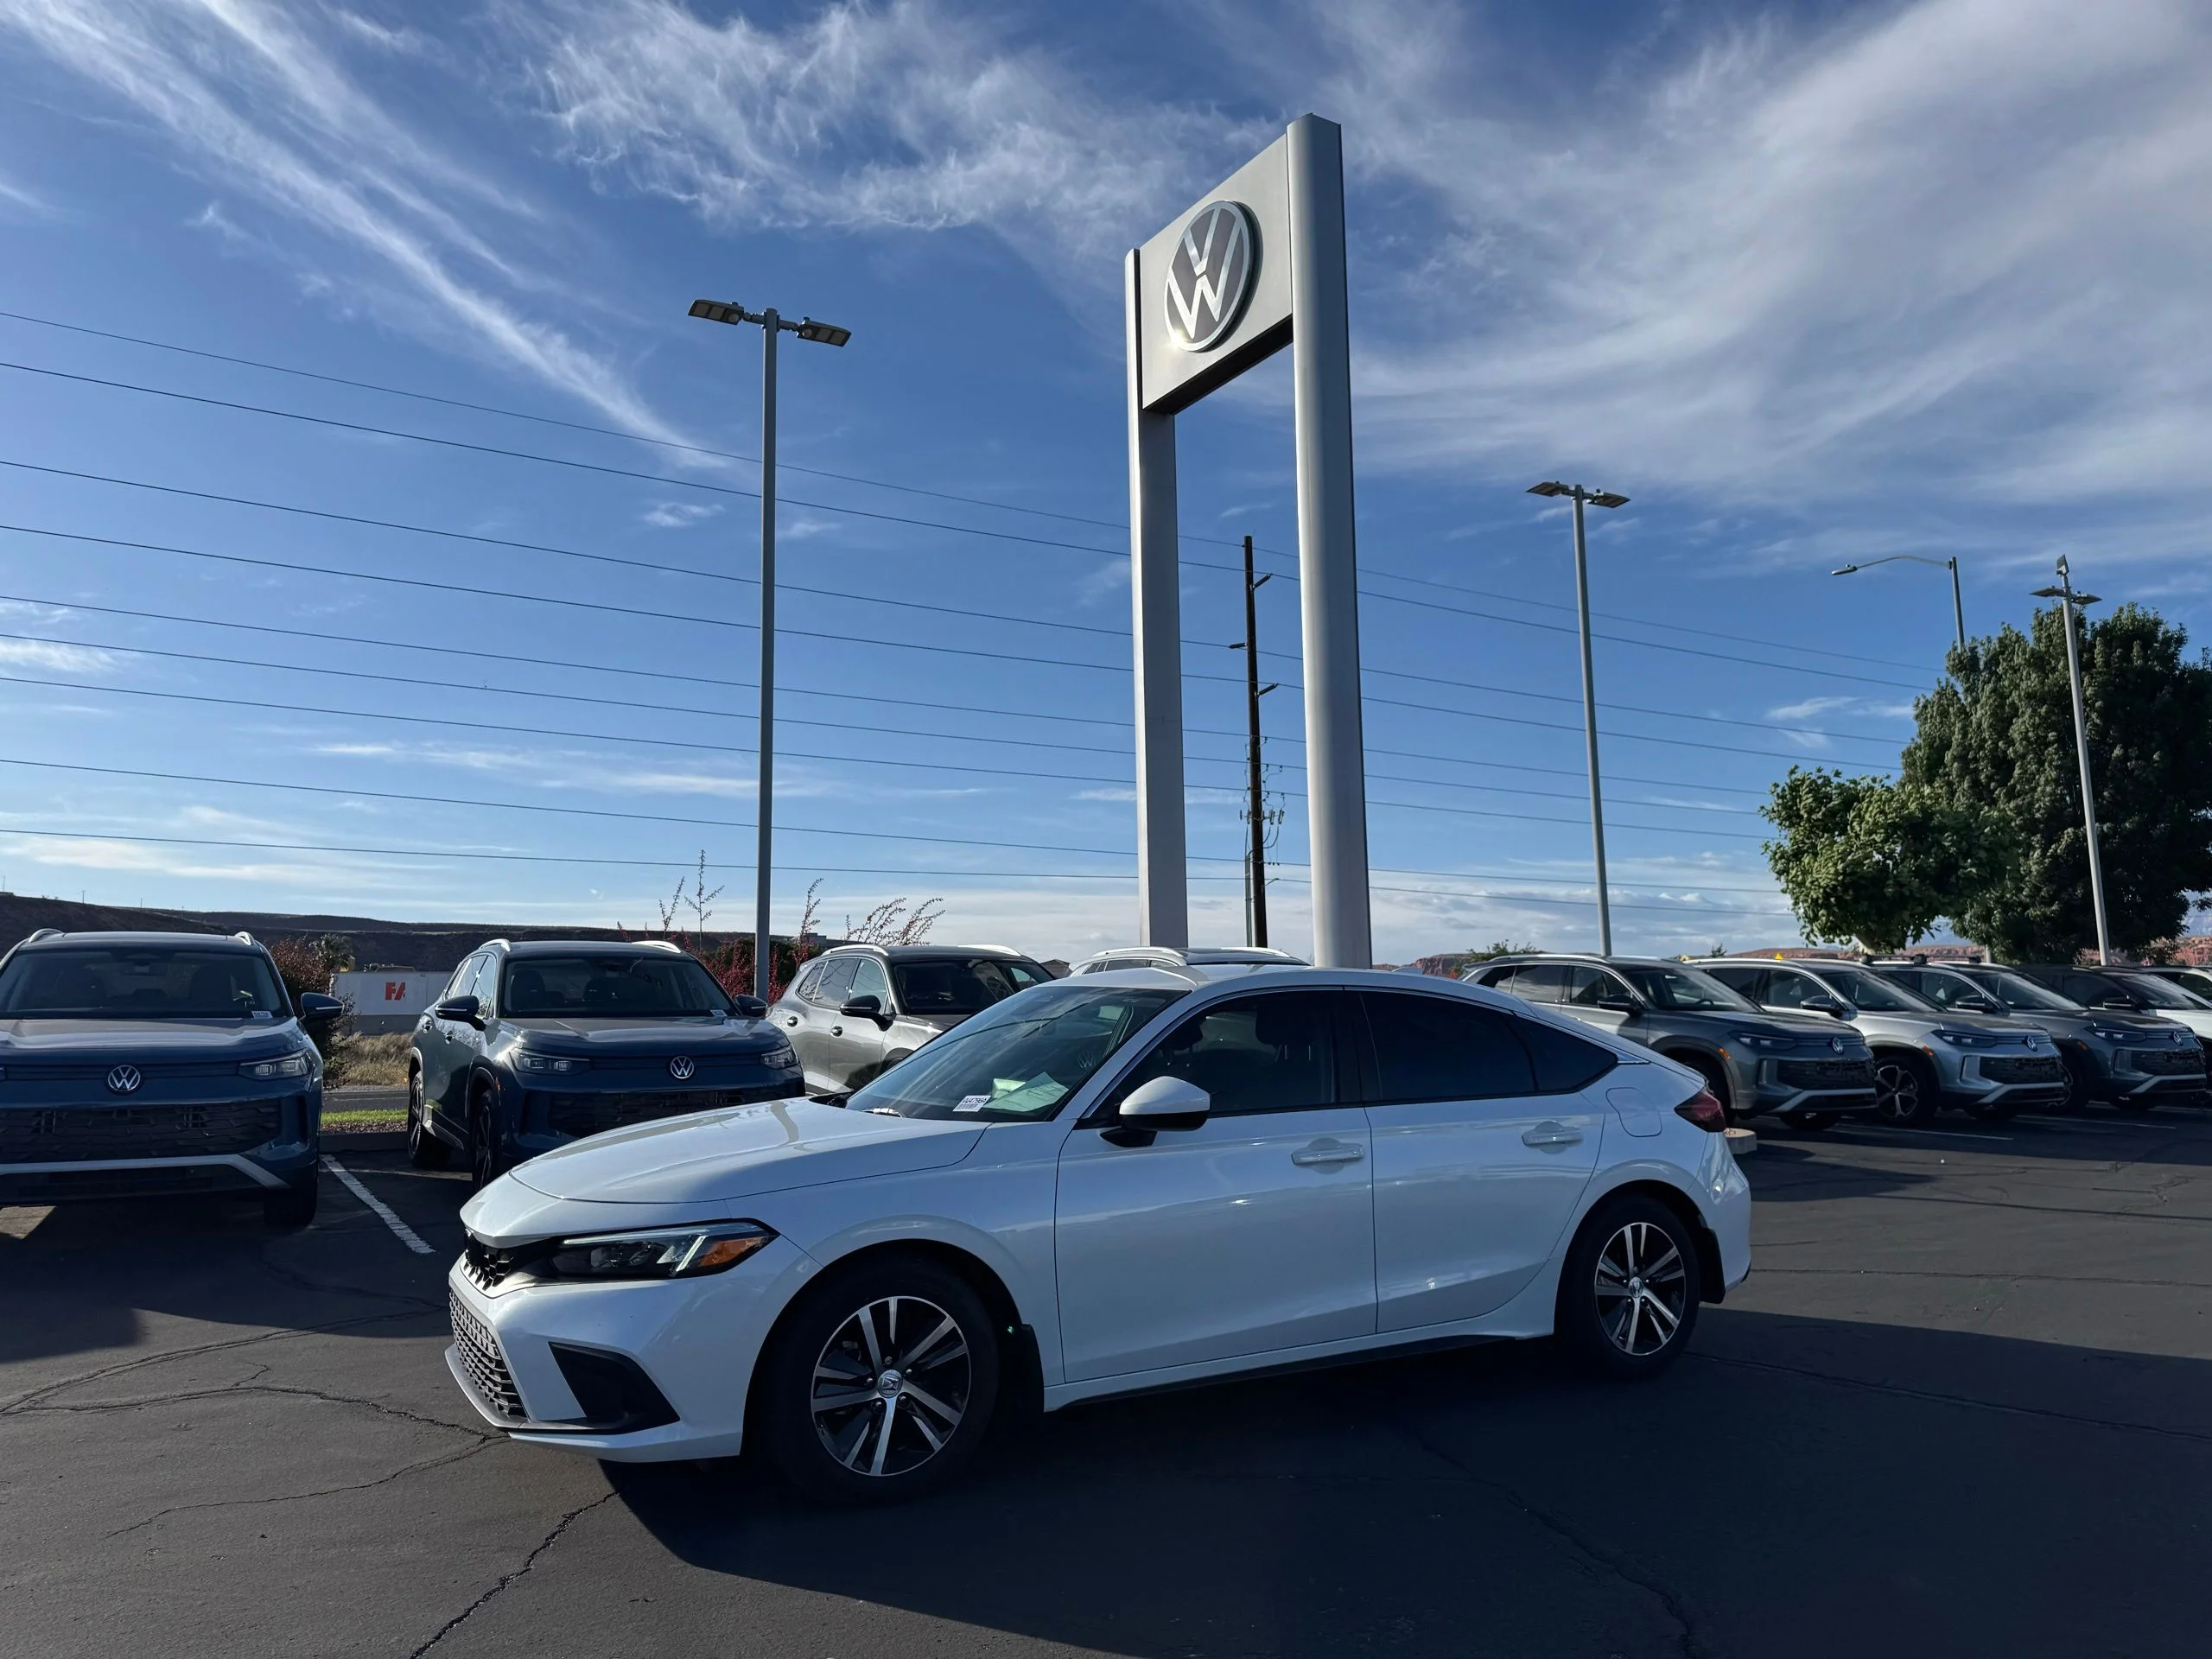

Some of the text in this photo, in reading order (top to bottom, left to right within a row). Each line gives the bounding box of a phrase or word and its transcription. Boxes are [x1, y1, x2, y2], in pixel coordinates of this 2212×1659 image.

[1166, 202, 1249, 347] VW
[108, 1065, 140, 1090] VW
[670, 1056, 694, 1078] VW
